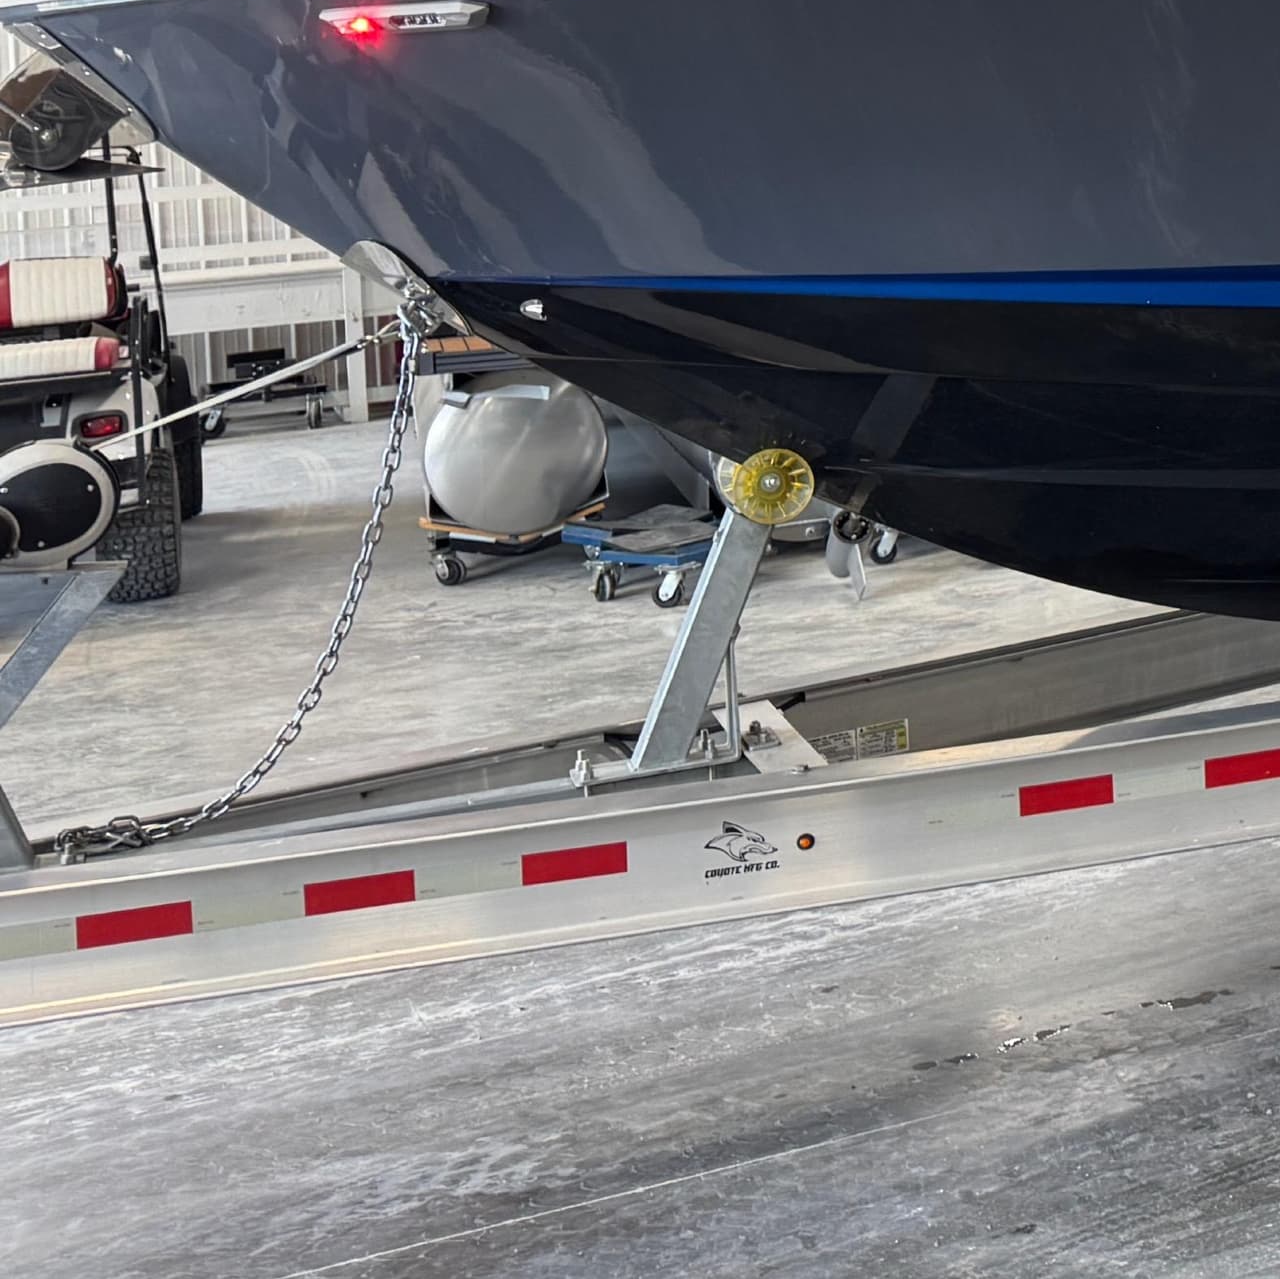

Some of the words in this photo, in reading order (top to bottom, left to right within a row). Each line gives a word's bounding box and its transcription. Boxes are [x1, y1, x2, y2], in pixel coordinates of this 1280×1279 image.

[704, 865, 742, 879] COYOTE
[743, 862, 764, 873] MFG
[765, 860, 780, 870] CO.
